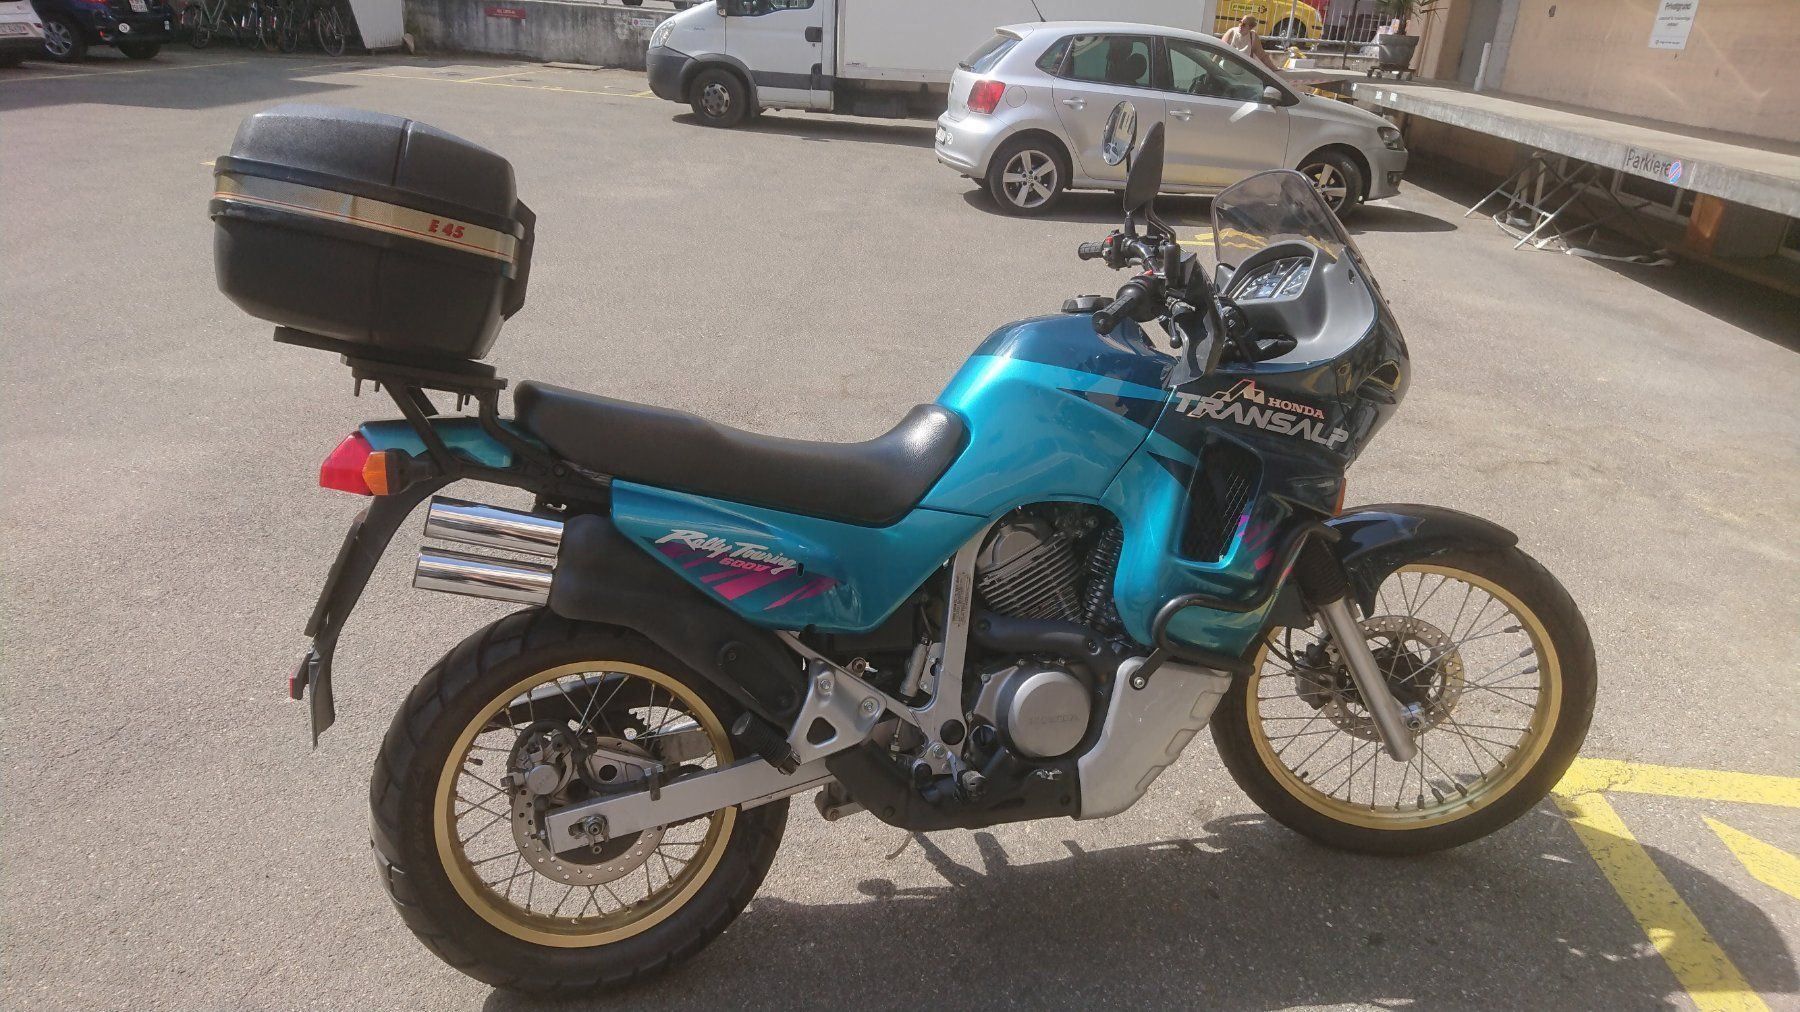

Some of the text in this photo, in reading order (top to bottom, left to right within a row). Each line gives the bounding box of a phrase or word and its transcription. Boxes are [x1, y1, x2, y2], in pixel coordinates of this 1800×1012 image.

[428, 219, 465, 239] E 45
[1174, 391, 1349, 451] TRANSALP
[1268, 397, 1325, 420] HONDA
[655, 529, 799, 575] Rally Touring
